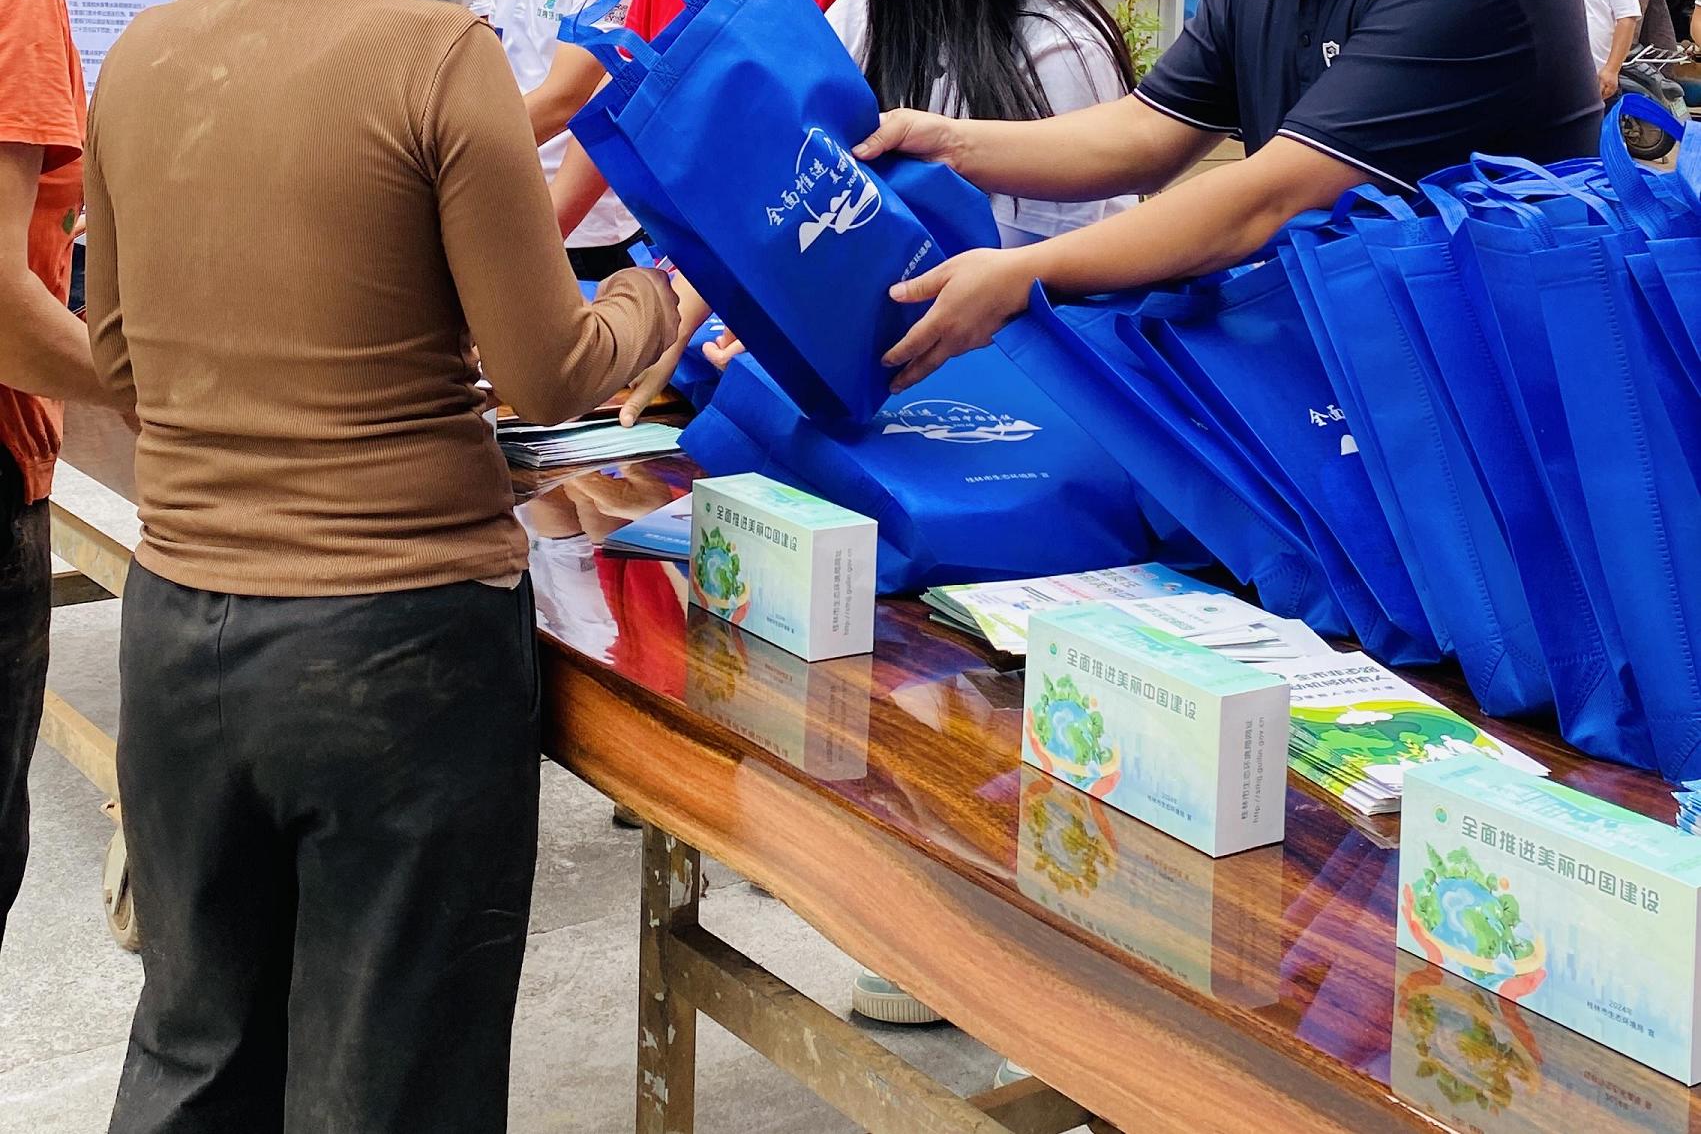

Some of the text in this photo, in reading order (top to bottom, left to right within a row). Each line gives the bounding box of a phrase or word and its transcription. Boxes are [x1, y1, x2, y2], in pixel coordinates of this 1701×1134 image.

[765, 157, 829, 226] 全面推进
[716, 504, 799, 552] 全面推进美丽中国建设
[1066, 647, 1197, 721] 全面推进美丽中国建设
[1461, 815, 1660, 914] 全面推进美丽中国建设
